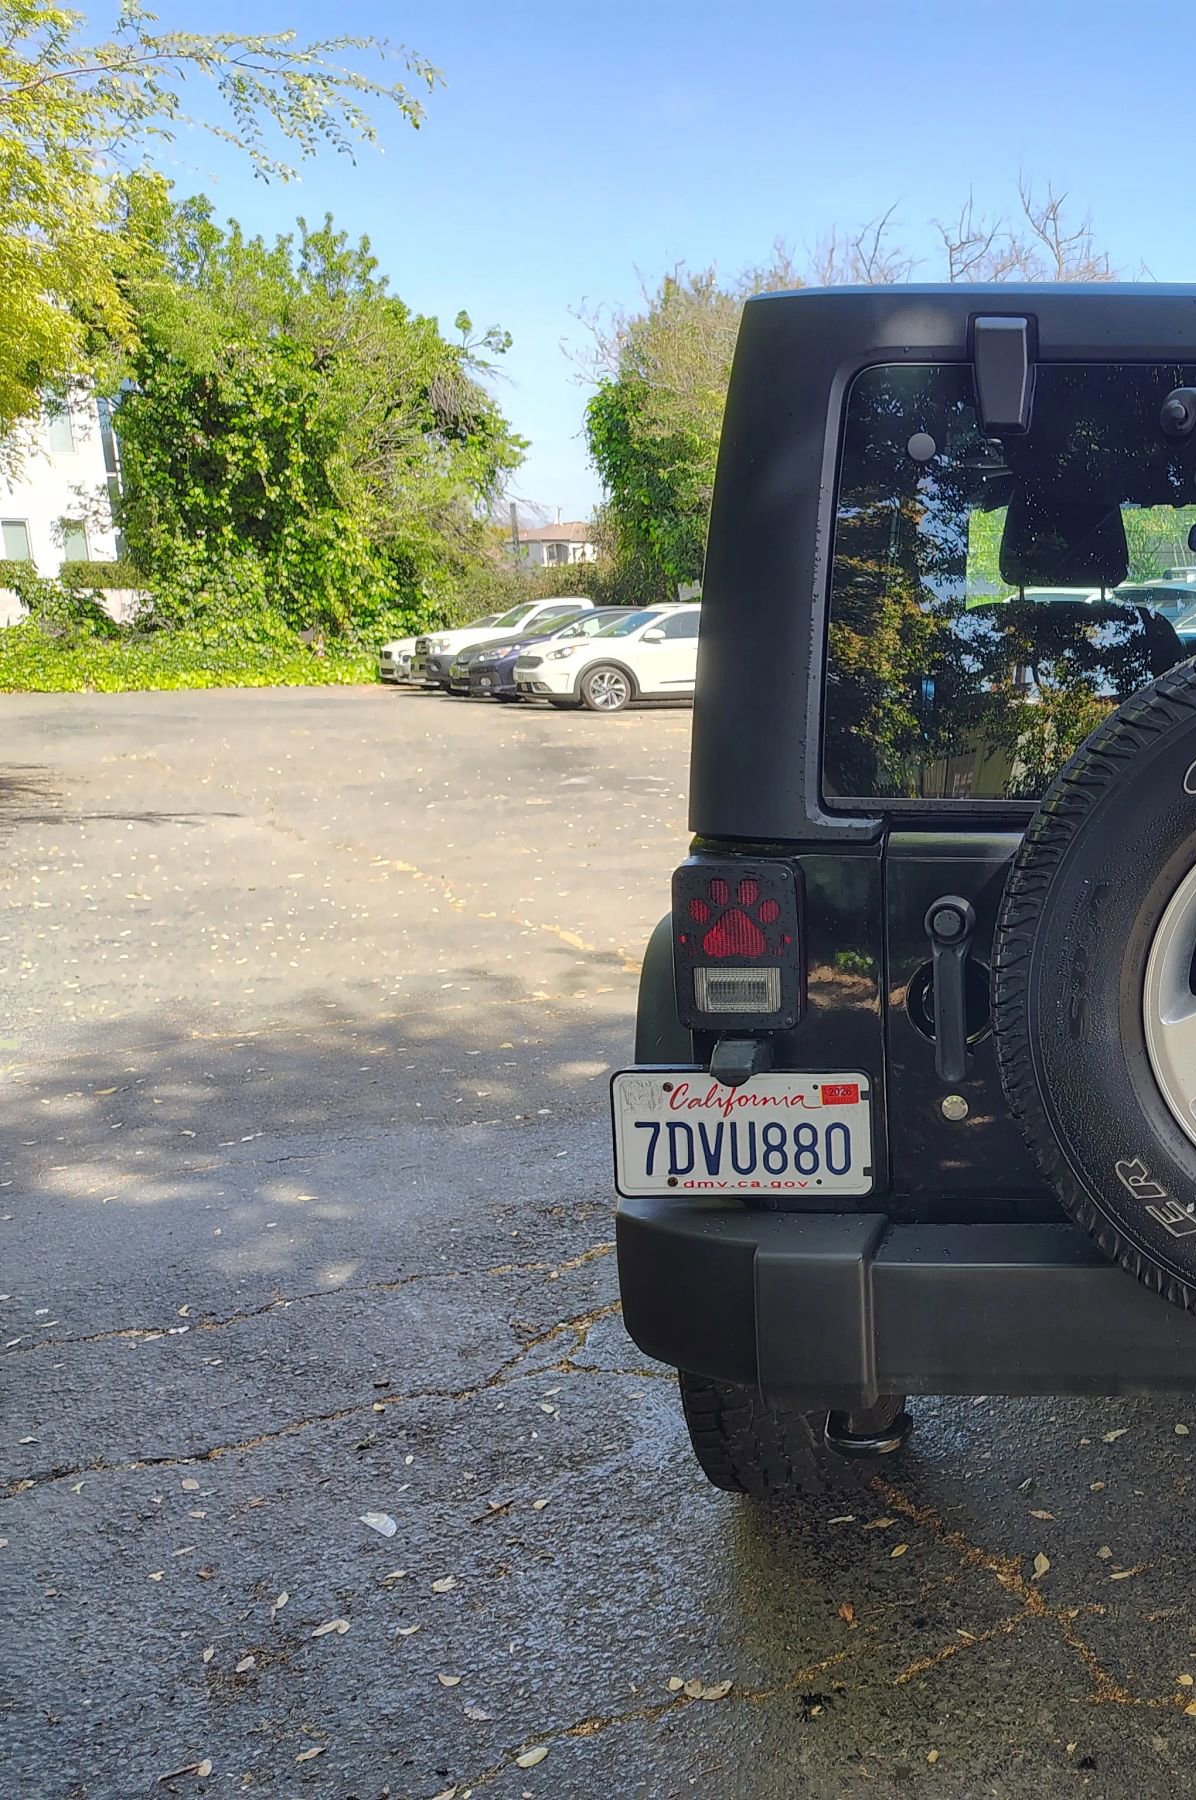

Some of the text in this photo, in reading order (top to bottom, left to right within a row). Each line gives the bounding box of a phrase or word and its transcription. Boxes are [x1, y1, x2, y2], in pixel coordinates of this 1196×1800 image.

[668, 1082, 823, 1118] California
[828, 1087, 852, 1096] 2026
[634, 1121, 852, 1176] 7DVU880
[683, 1179, 809, 1189] dmv.ca.gov
